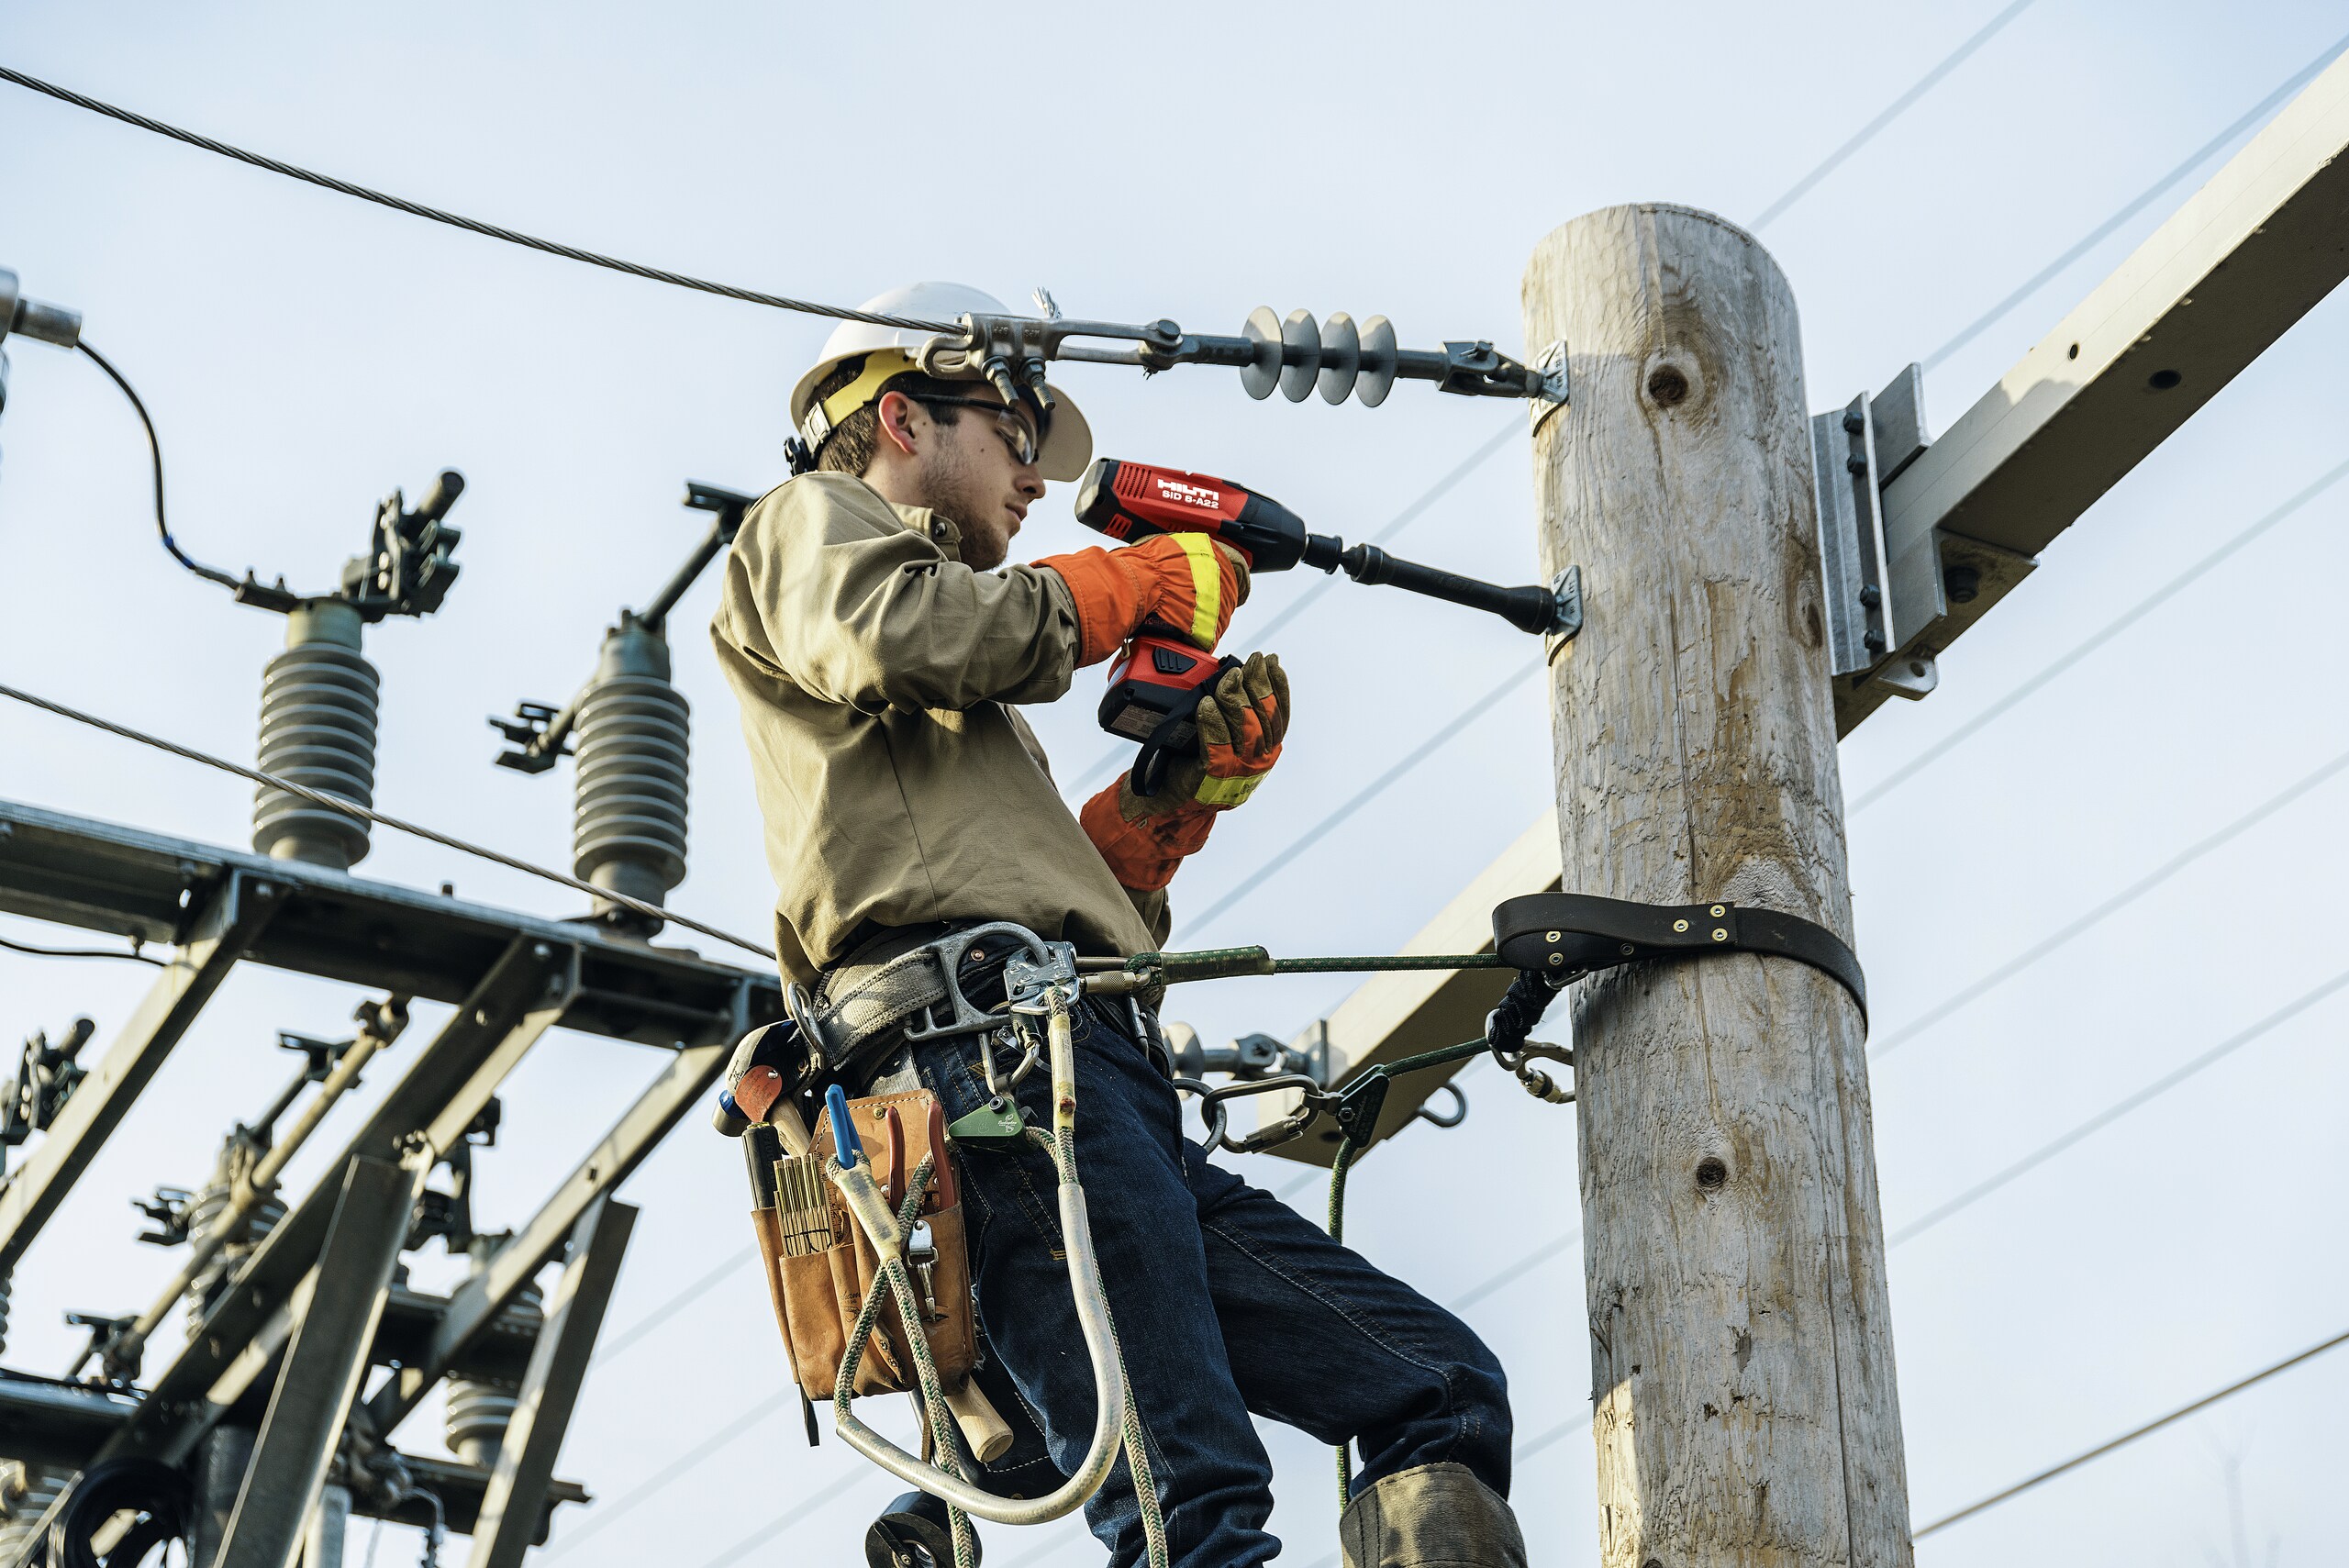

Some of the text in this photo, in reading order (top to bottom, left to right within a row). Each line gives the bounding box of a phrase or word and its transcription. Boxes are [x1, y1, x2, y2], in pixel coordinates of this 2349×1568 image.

[1157, 478, 1219, 501] HILTI
[1162, 490, 1219, 509] SID 8-A22
